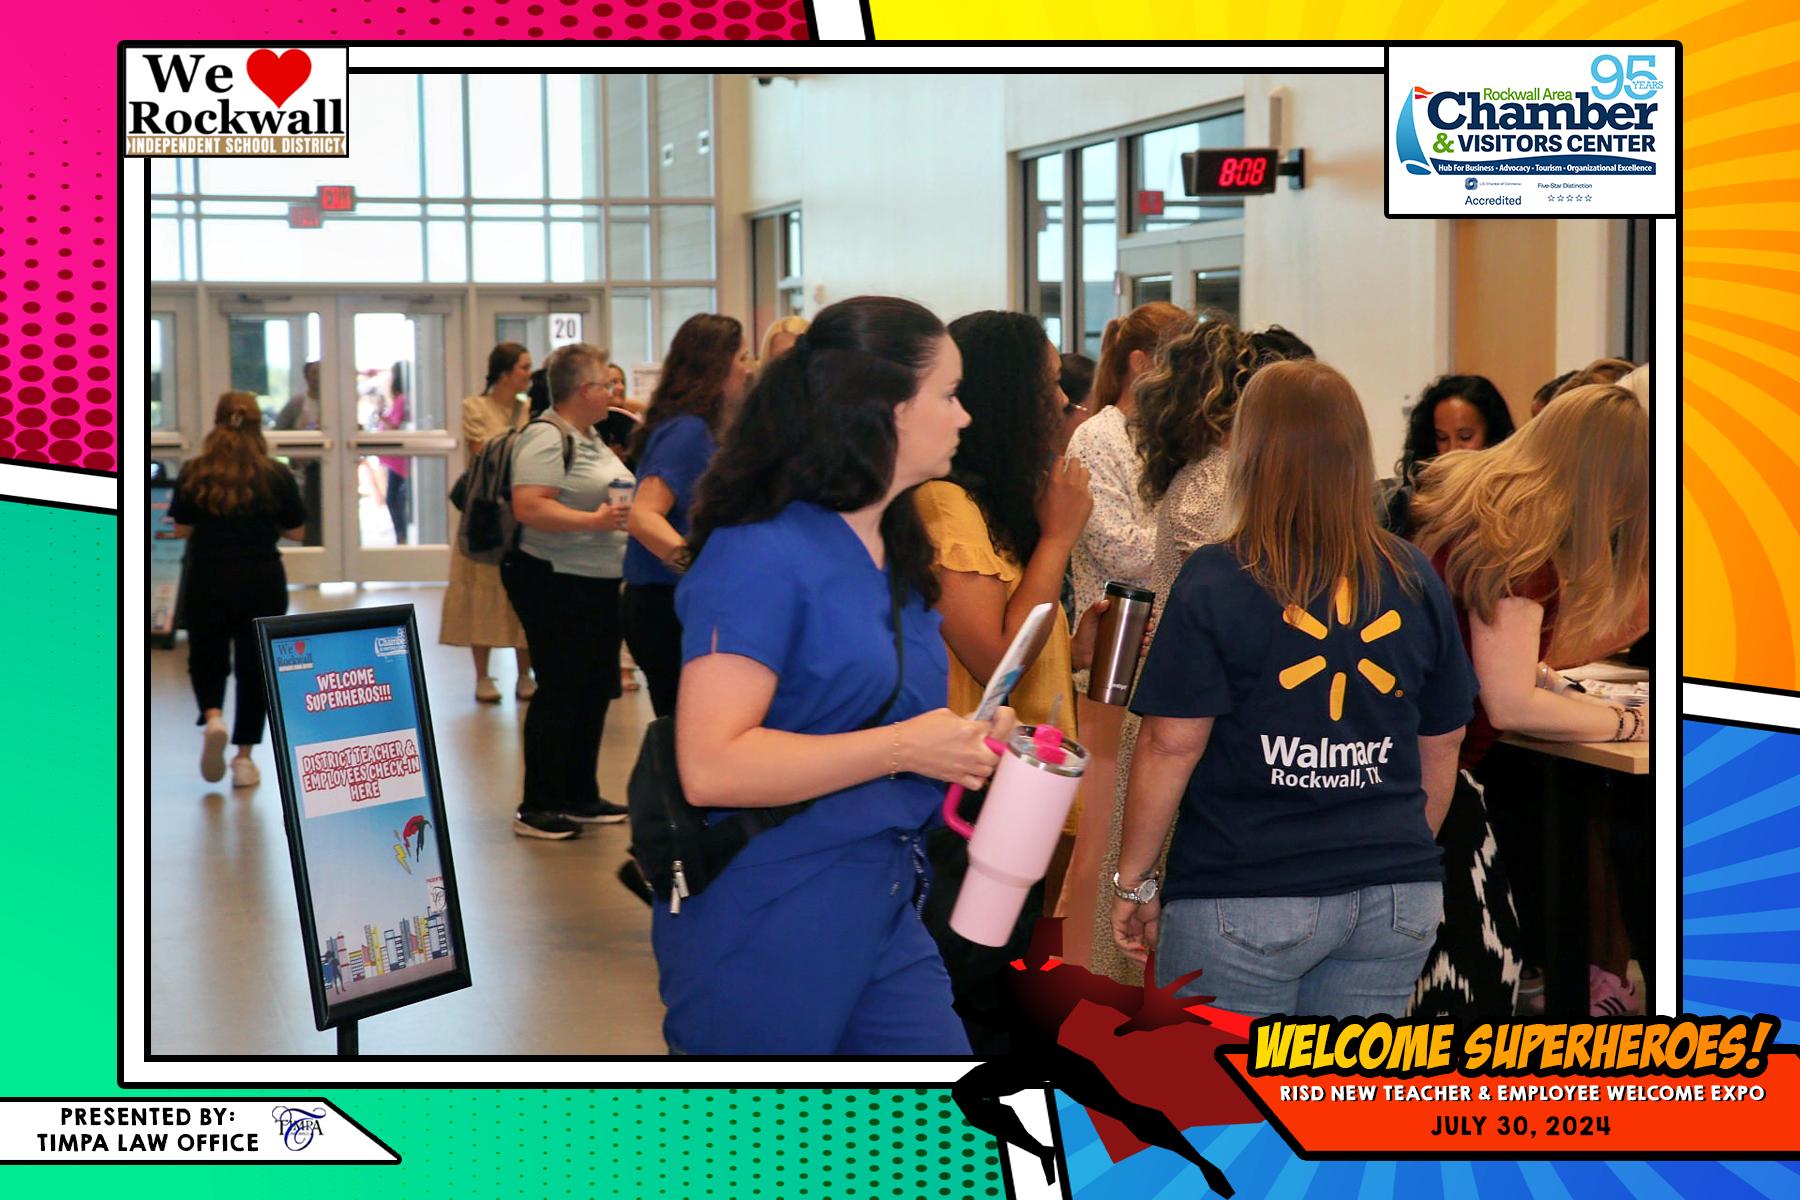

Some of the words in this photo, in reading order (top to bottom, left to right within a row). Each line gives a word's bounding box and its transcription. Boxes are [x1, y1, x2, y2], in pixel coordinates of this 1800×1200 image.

[1218, 157, 1268, 188] 8:08
[555, 318, 577, 339] 20
[316, 667, 377, 693] WELCOME
[305, 684, 393, 713] SUPERHEROS!!!
[302, 747, 353, 774] DISTRICT
[351, 740, 405, 767] TEACHER
[404, 739, 418, 758] &
[1260, 734, 1394, 769] Walmart
[302, 763, 369, 792] EMPLOYEES
[366, 756, 421, 781] CHECK-IN
[1270, 767, 1366, 789] Rockwall,
[1365, 766, 1383, 785] TX
[349, 780, 381, 802] HERE
